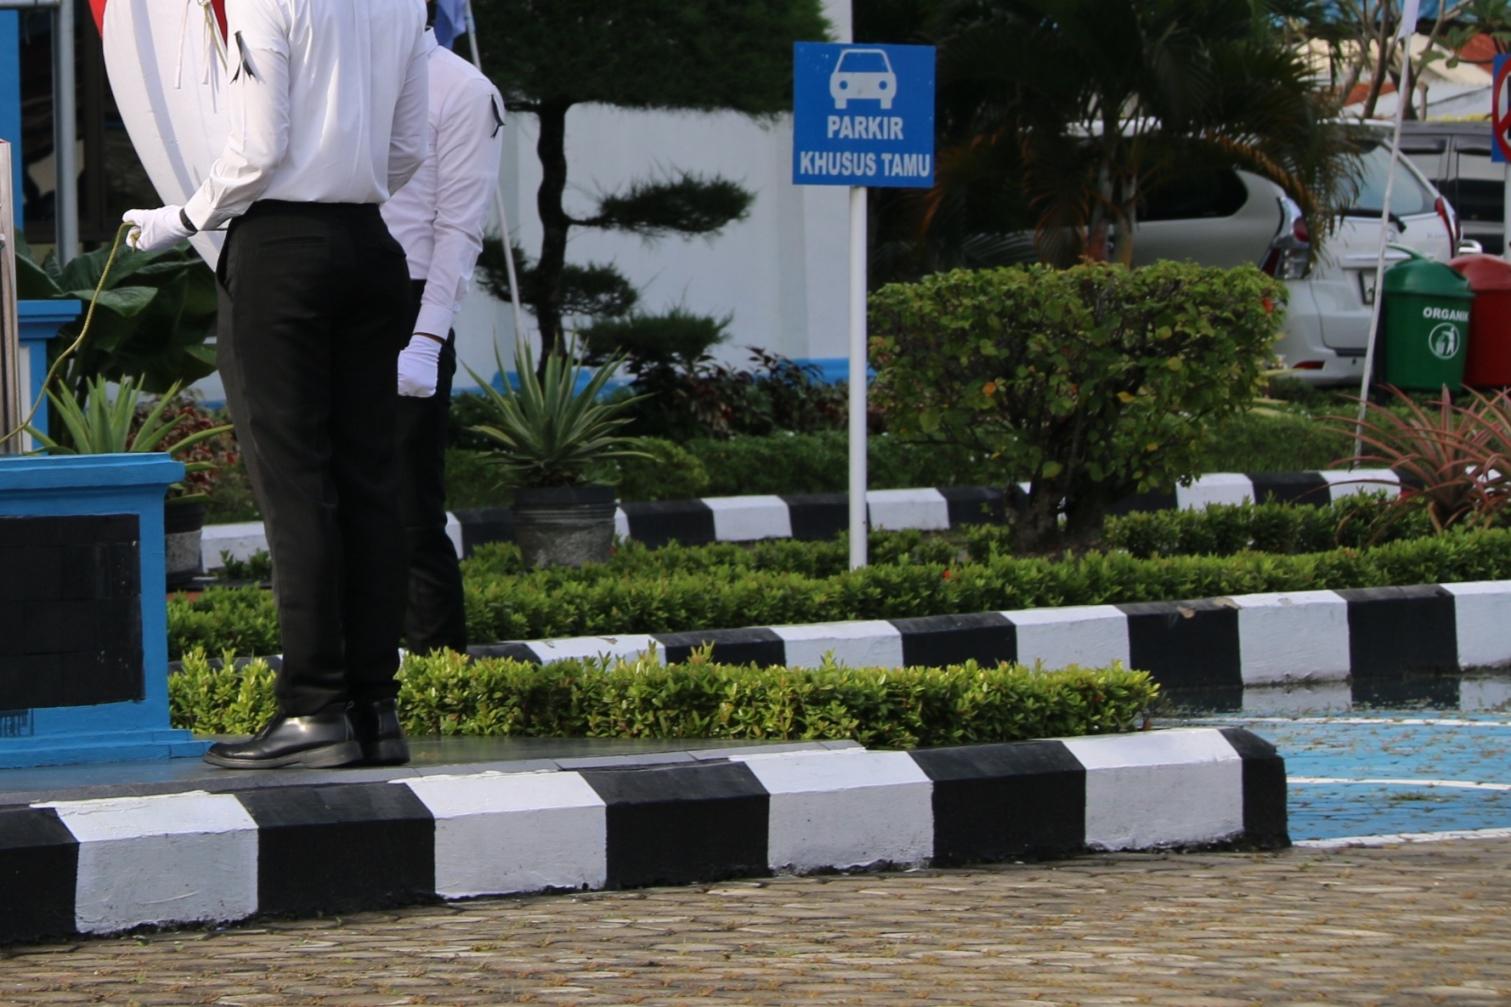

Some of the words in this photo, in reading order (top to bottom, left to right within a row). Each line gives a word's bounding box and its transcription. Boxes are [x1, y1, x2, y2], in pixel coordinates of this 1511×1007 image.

[827, 115, 904, 140] PARKIR
[800, 151, 876, 176] KHUSUS
[881, 153, 930, 177] TAMU
